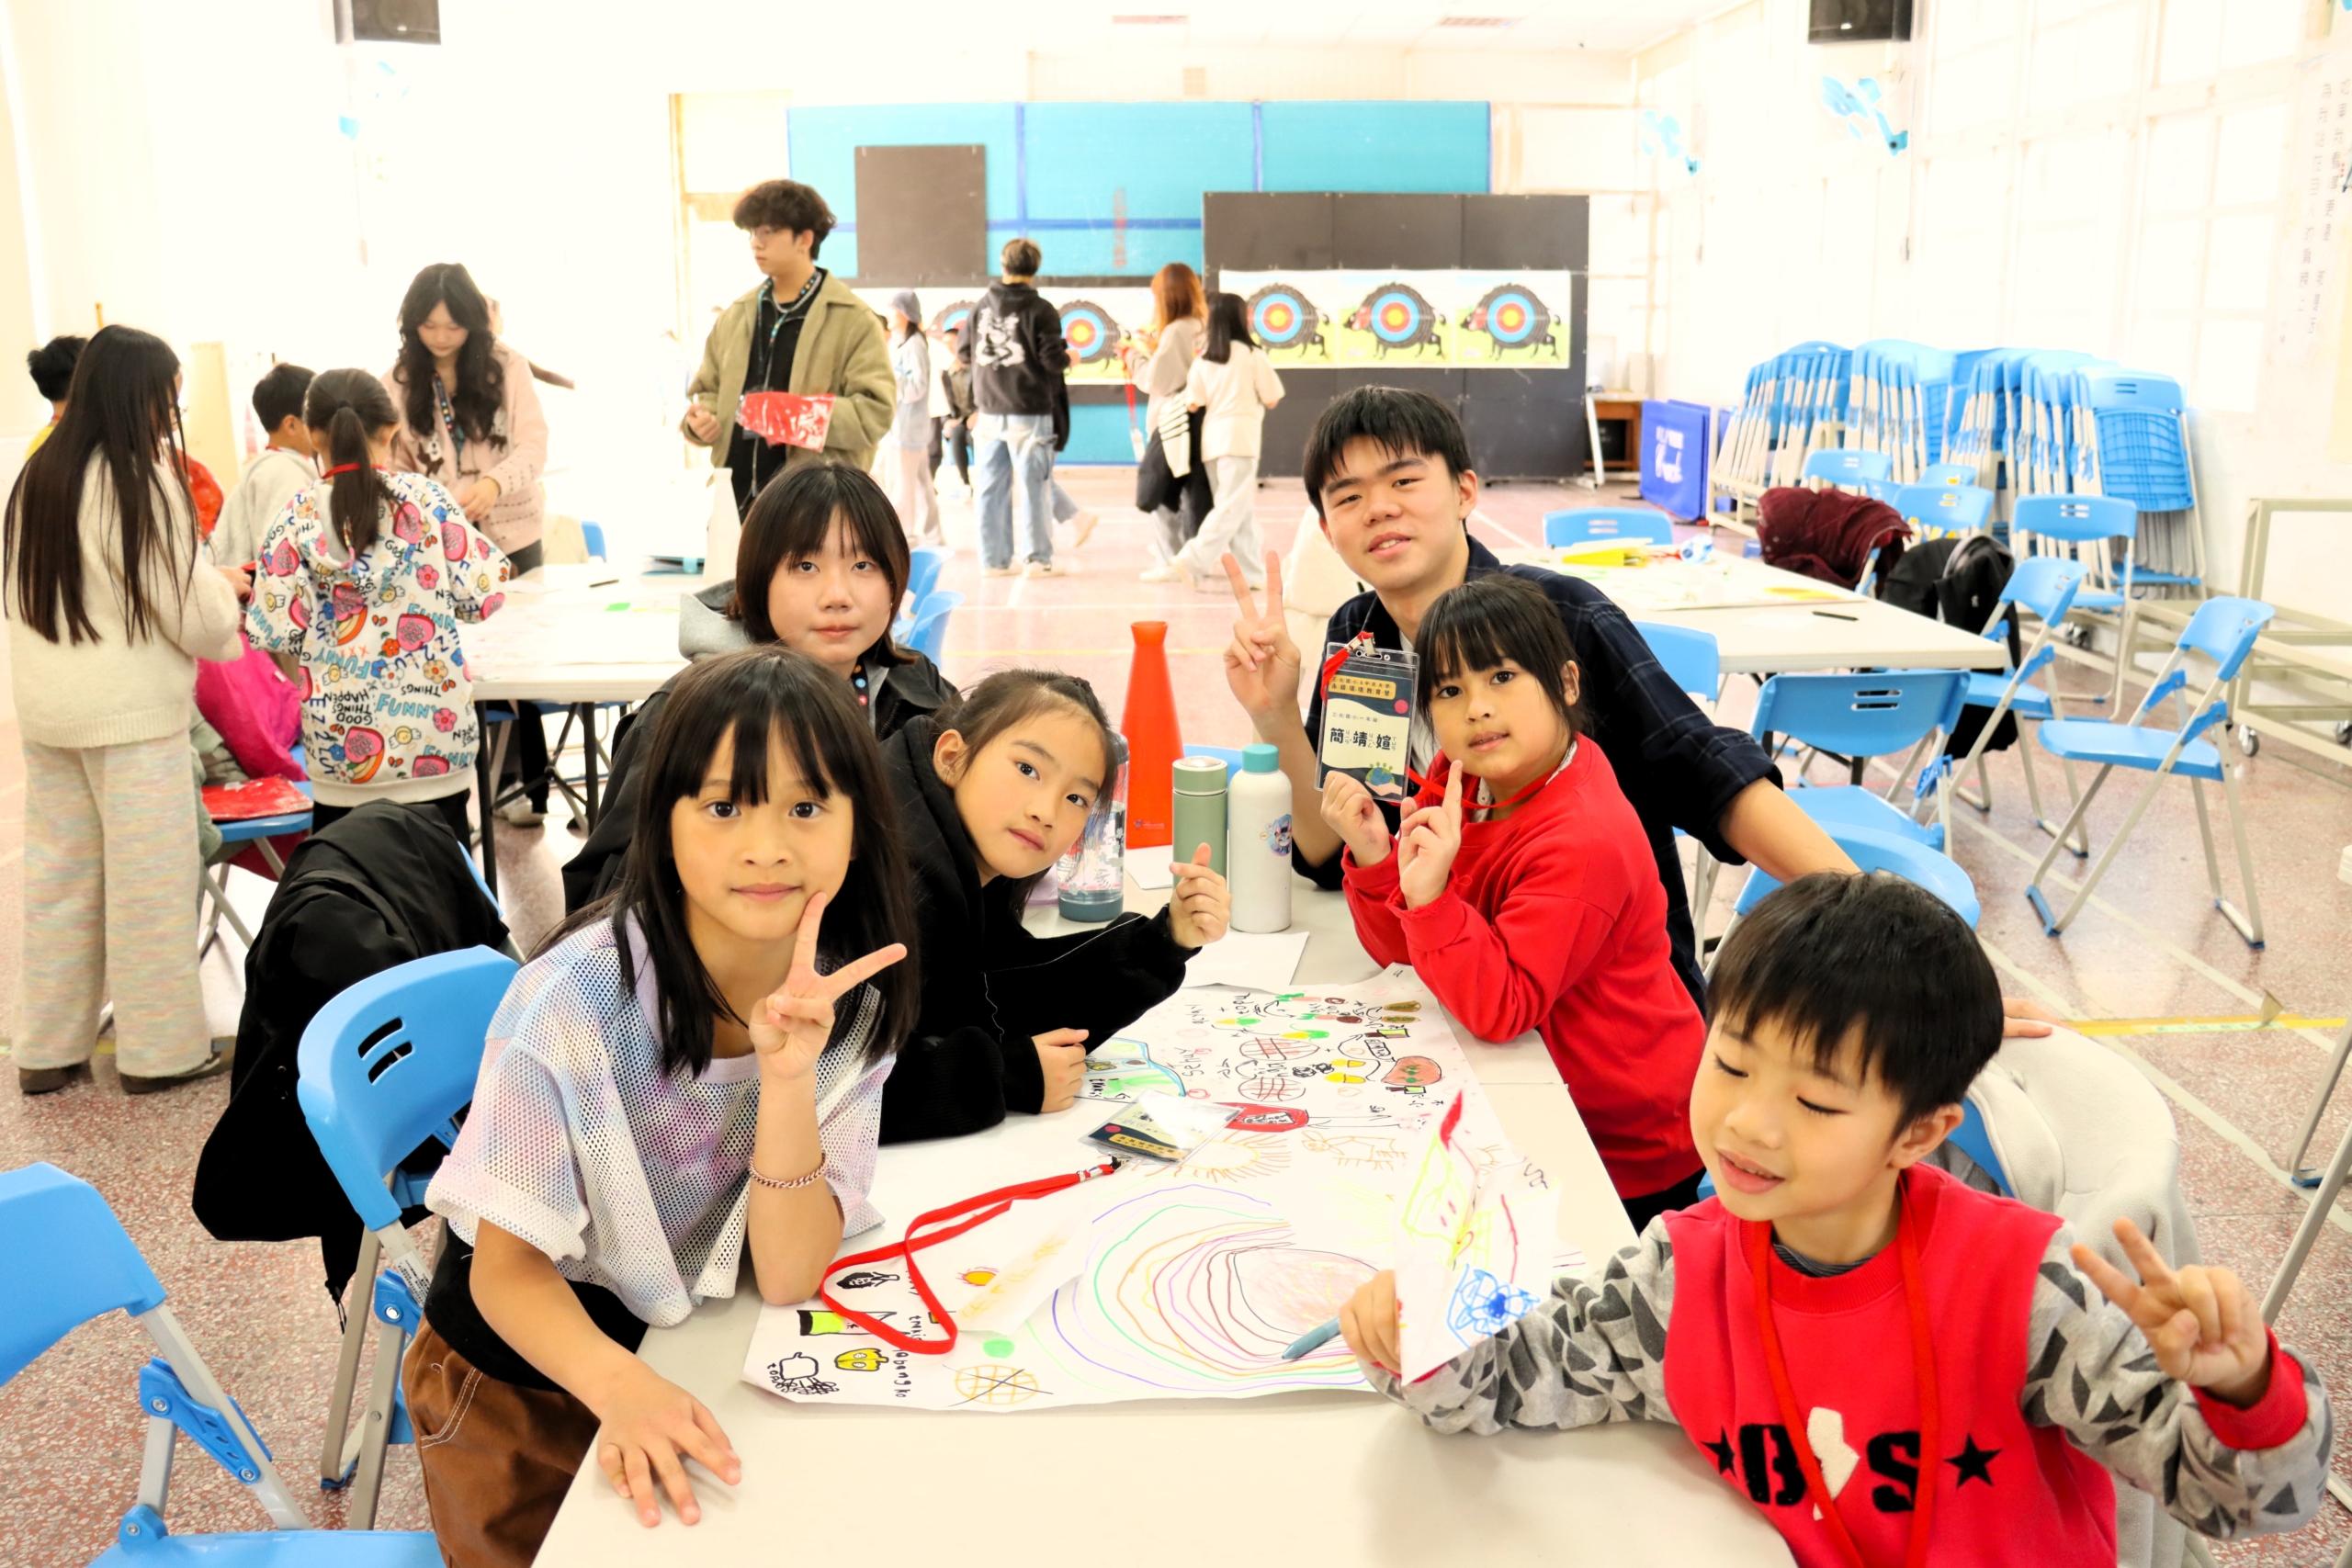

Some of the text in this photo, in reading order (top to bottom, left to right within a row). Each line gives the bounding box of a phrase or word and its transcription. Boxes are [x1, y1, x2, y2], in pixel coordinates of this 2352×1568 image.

[323, 688, 369, 704] HAPPEN
[401, 683, 442, 697] THINGS
[332, 703, 372, 716] THINGS
[336, 713, 373, 726] GOOD
